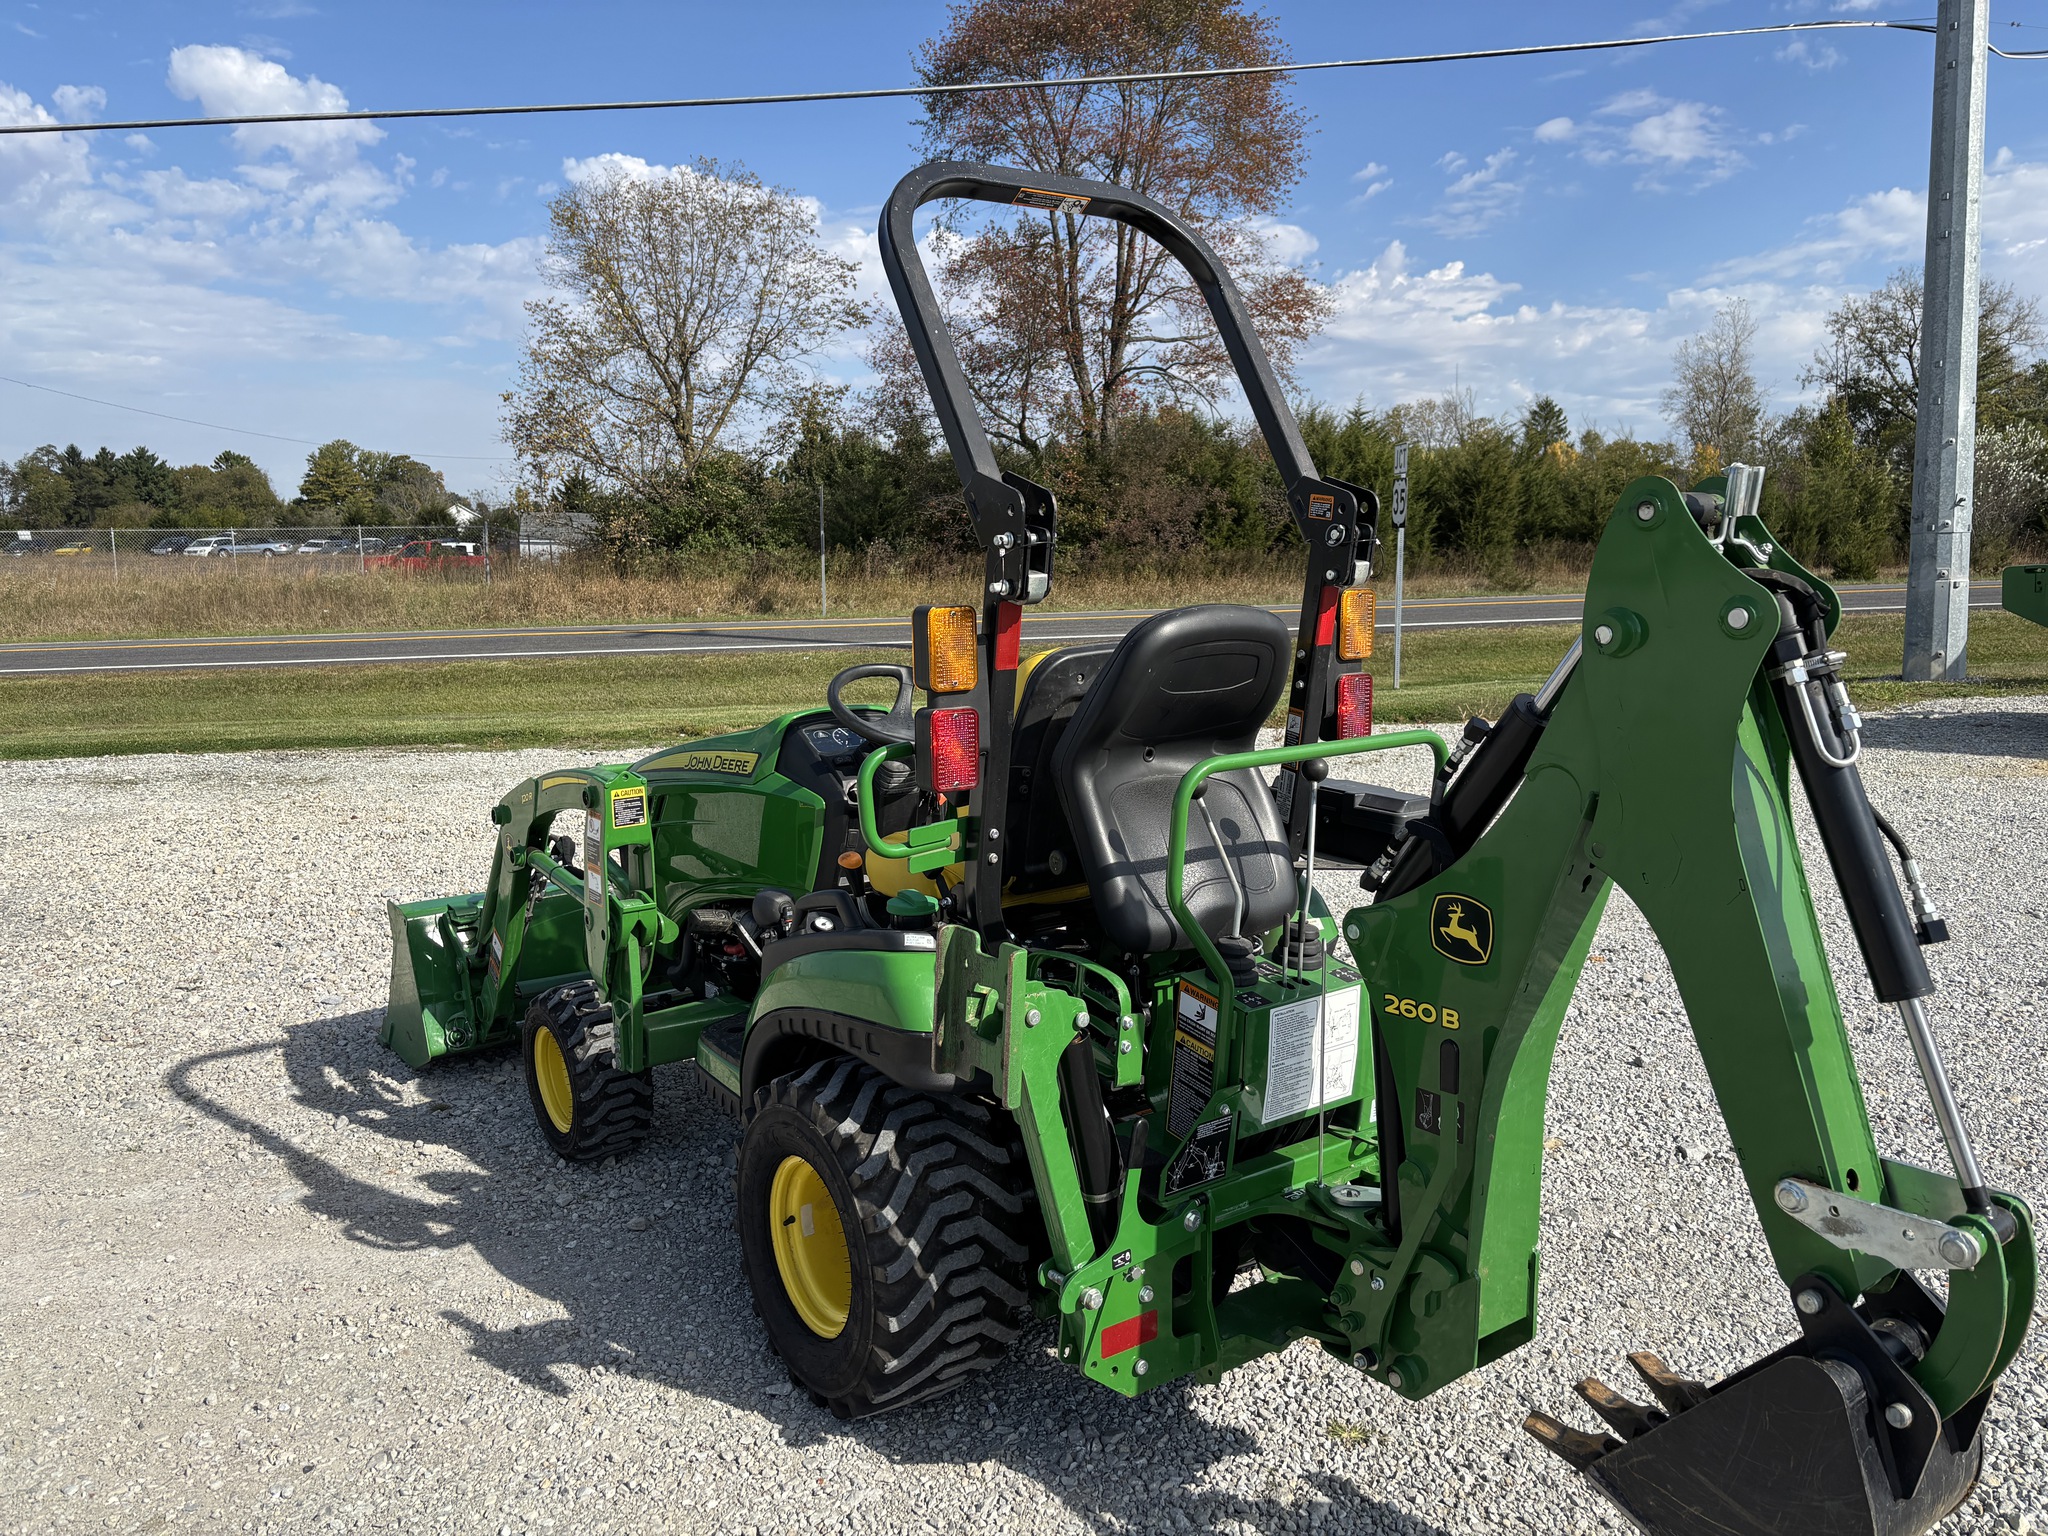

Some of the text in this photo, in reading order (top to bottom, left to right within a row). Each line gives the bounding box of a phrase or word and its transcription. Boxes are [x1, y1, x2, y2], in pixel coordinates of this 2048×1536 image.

[1395, 448, 1407, 470] JCT
[1393, 488, 1406, 515] 35
[684, 754, 750, 772] JOHN DEERE
[620, 788, 644, 797] CAUTION
[1190, 989, 1219, 1009] WARNING
[1384, 993, 1460, 1030] 260 B
[1186, 1040, 1214, 1061] CAUTION
